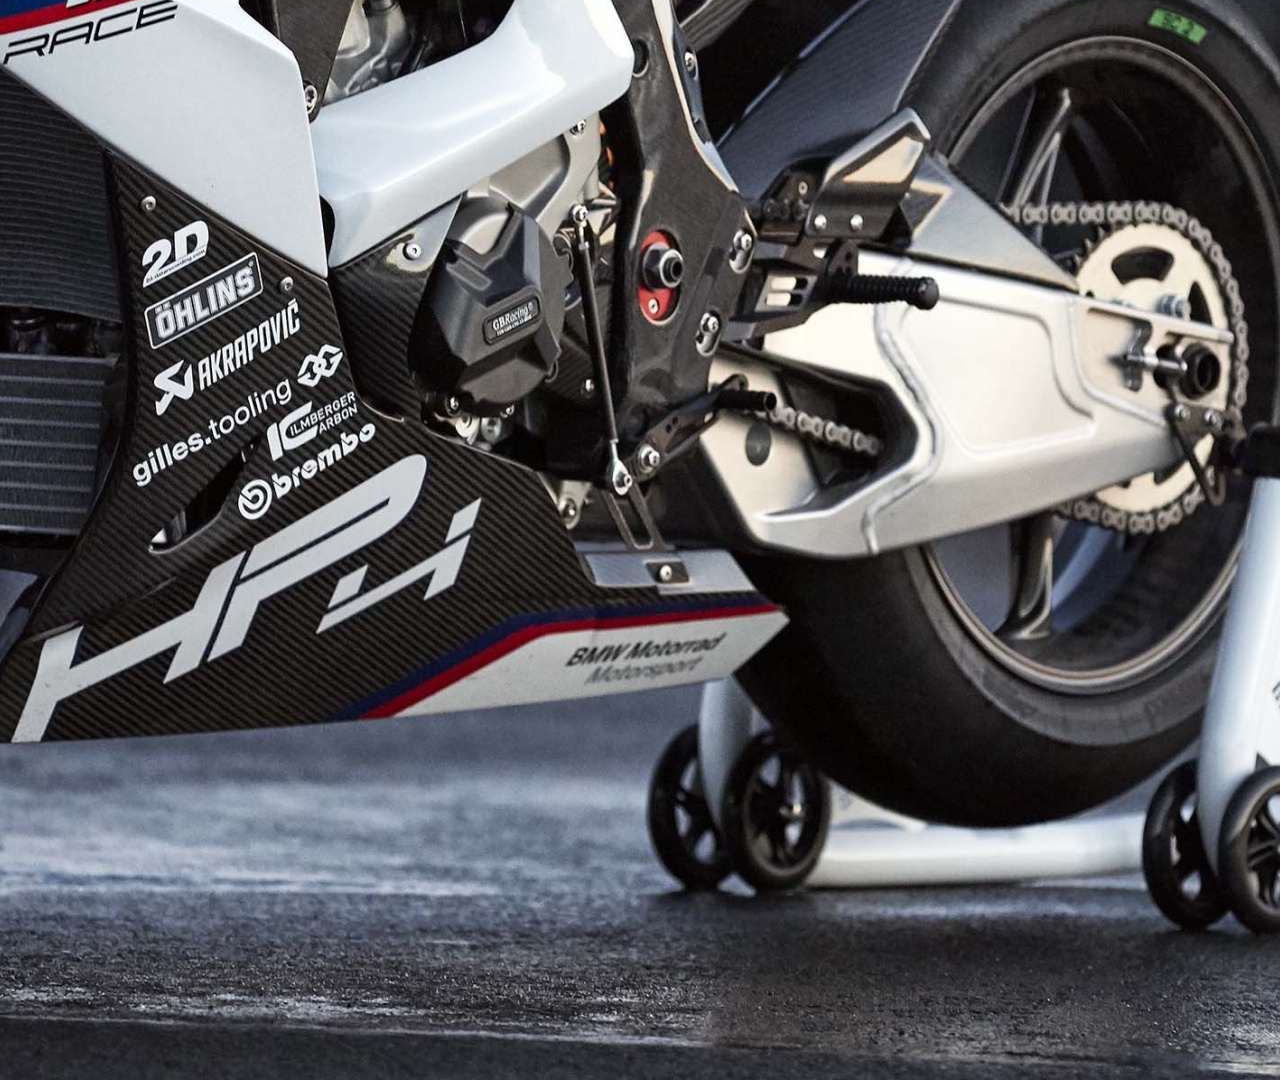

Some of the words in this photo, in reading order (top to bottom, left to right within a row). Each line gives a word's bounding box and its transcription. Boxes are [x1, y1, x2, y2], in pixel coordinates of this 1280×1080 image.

[142, 220, 209, 288] 2D
[154, 265, 256, 339] ÖHLINS
[132, 379, 292, 487] gilles.tooling
[290, 391, 356, 437] ILMBERGER
[271, 423, 376, 500] brembo
[565, 642, 630, 667] BMW
[624, 632, 728, 660] Motorrad
[583, 656, 704, 686] Motorsport
